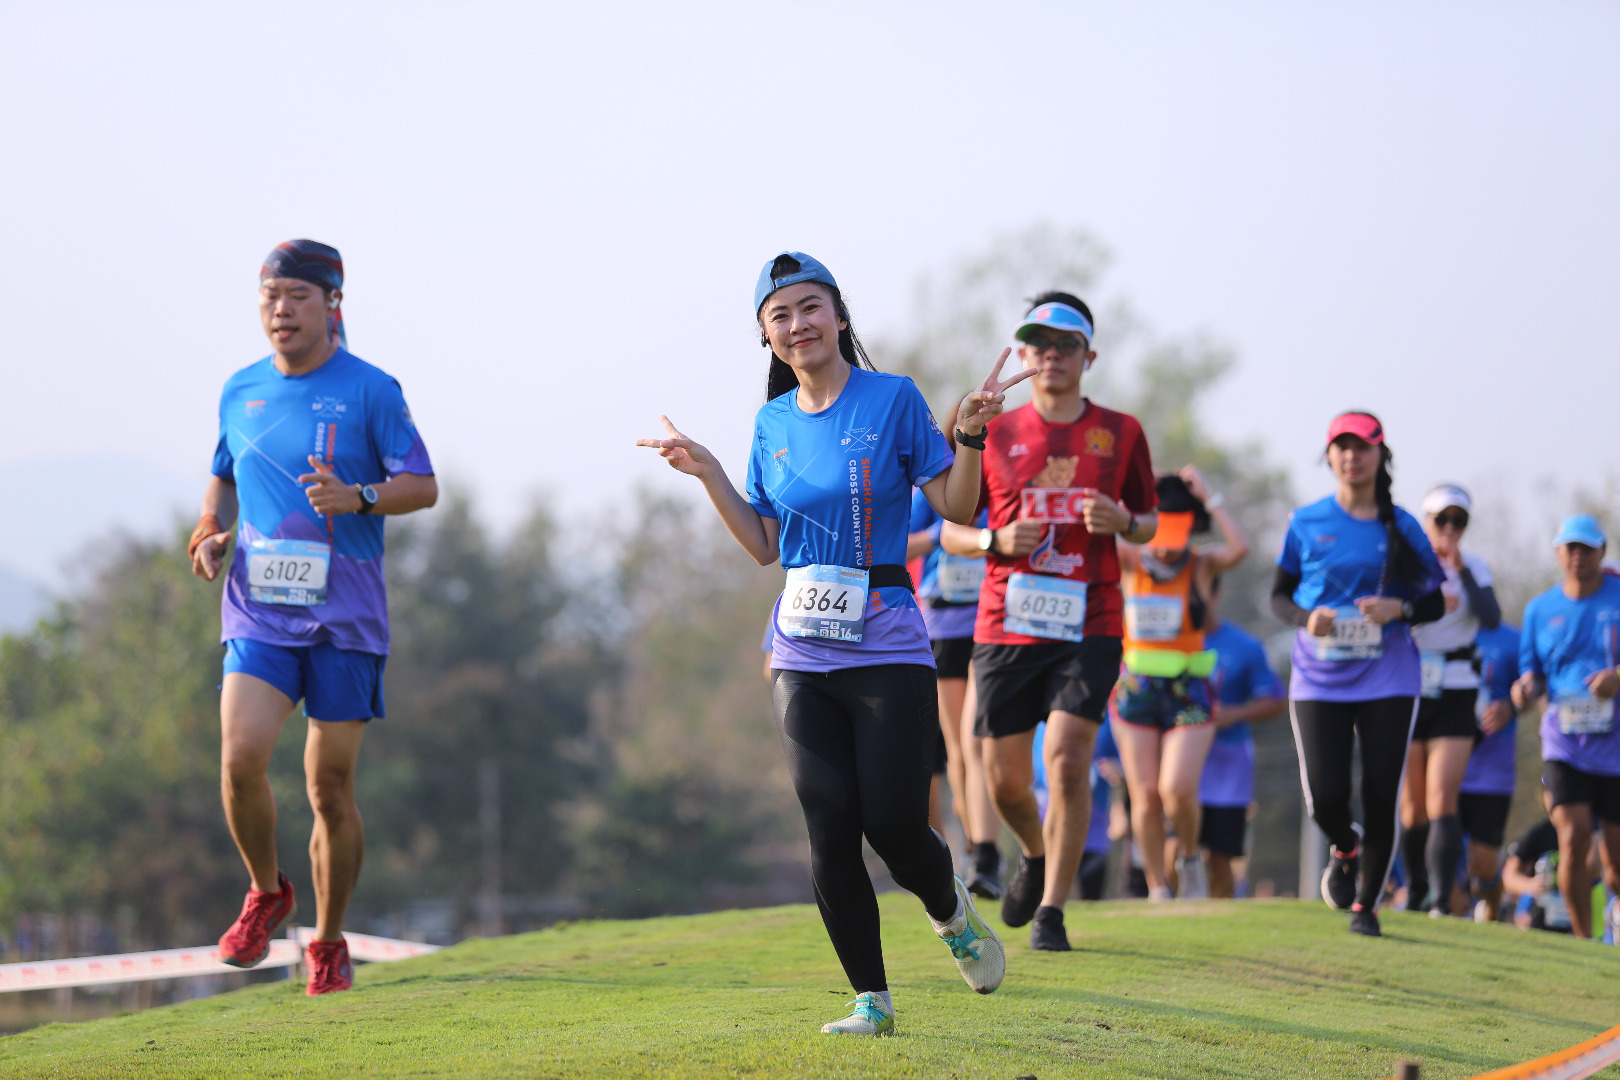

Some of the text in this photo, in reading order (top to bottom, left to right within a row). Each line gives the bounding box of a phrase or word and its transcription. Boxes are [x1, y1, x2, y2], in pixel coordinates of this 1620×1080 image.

[841, 433, 878, 446] SP XC
[849, 459, 859, 495] CROSS
[851, 497, 862, 549] COUNTRY
[861, 457, 883, 611] SINGHA PARK CHI RAI
[264, 561, 311, 582] 6102
[855, 551, 863, 567] RU
[792, 587, 848, 614] 6364
[1020, 594, 1072, 618] 6033
